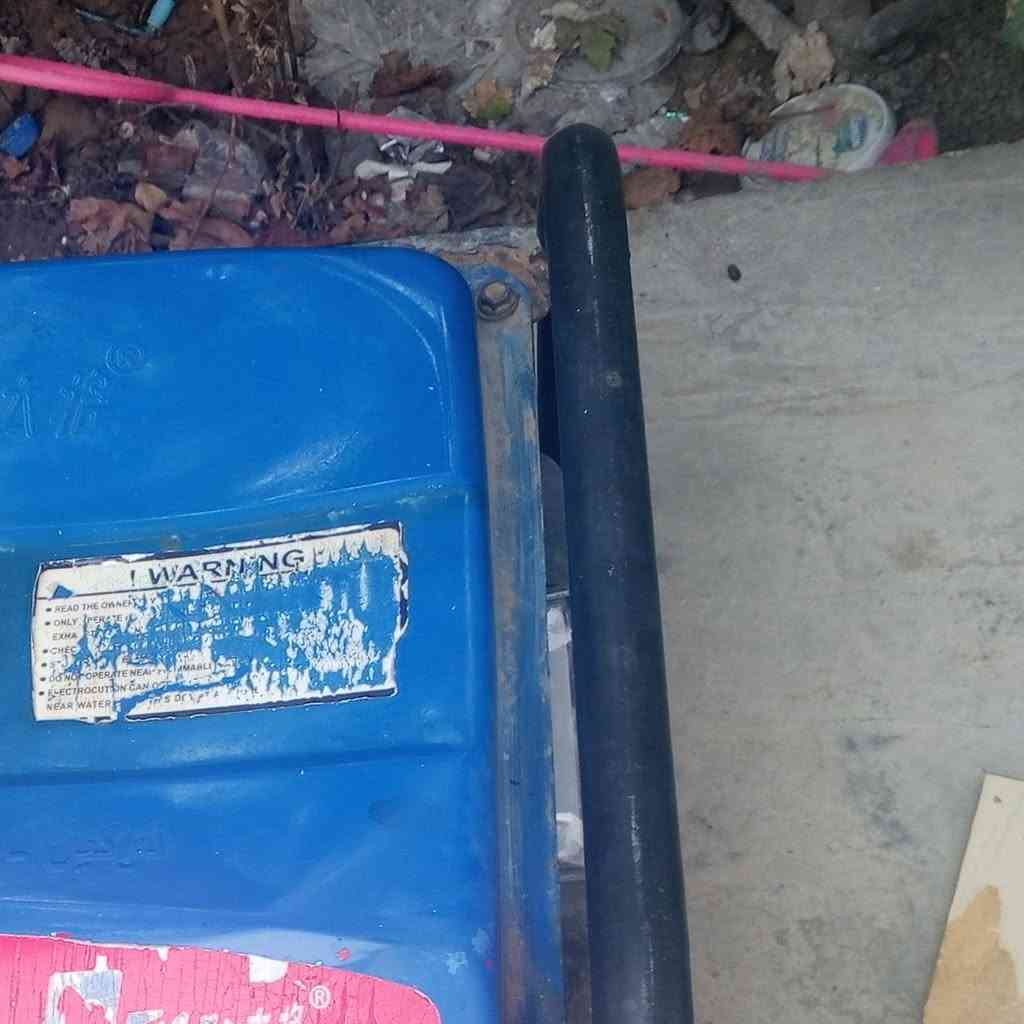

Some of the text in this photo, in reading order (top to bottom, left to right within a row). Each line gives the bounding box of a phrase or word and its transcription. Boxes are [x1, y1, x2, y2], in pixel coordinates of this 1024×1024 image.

[148, 550, 305, 585] WARNNG
[53, 618, 78, 626] ONLY
[47, 699, 112, 711] NEAR WATER
